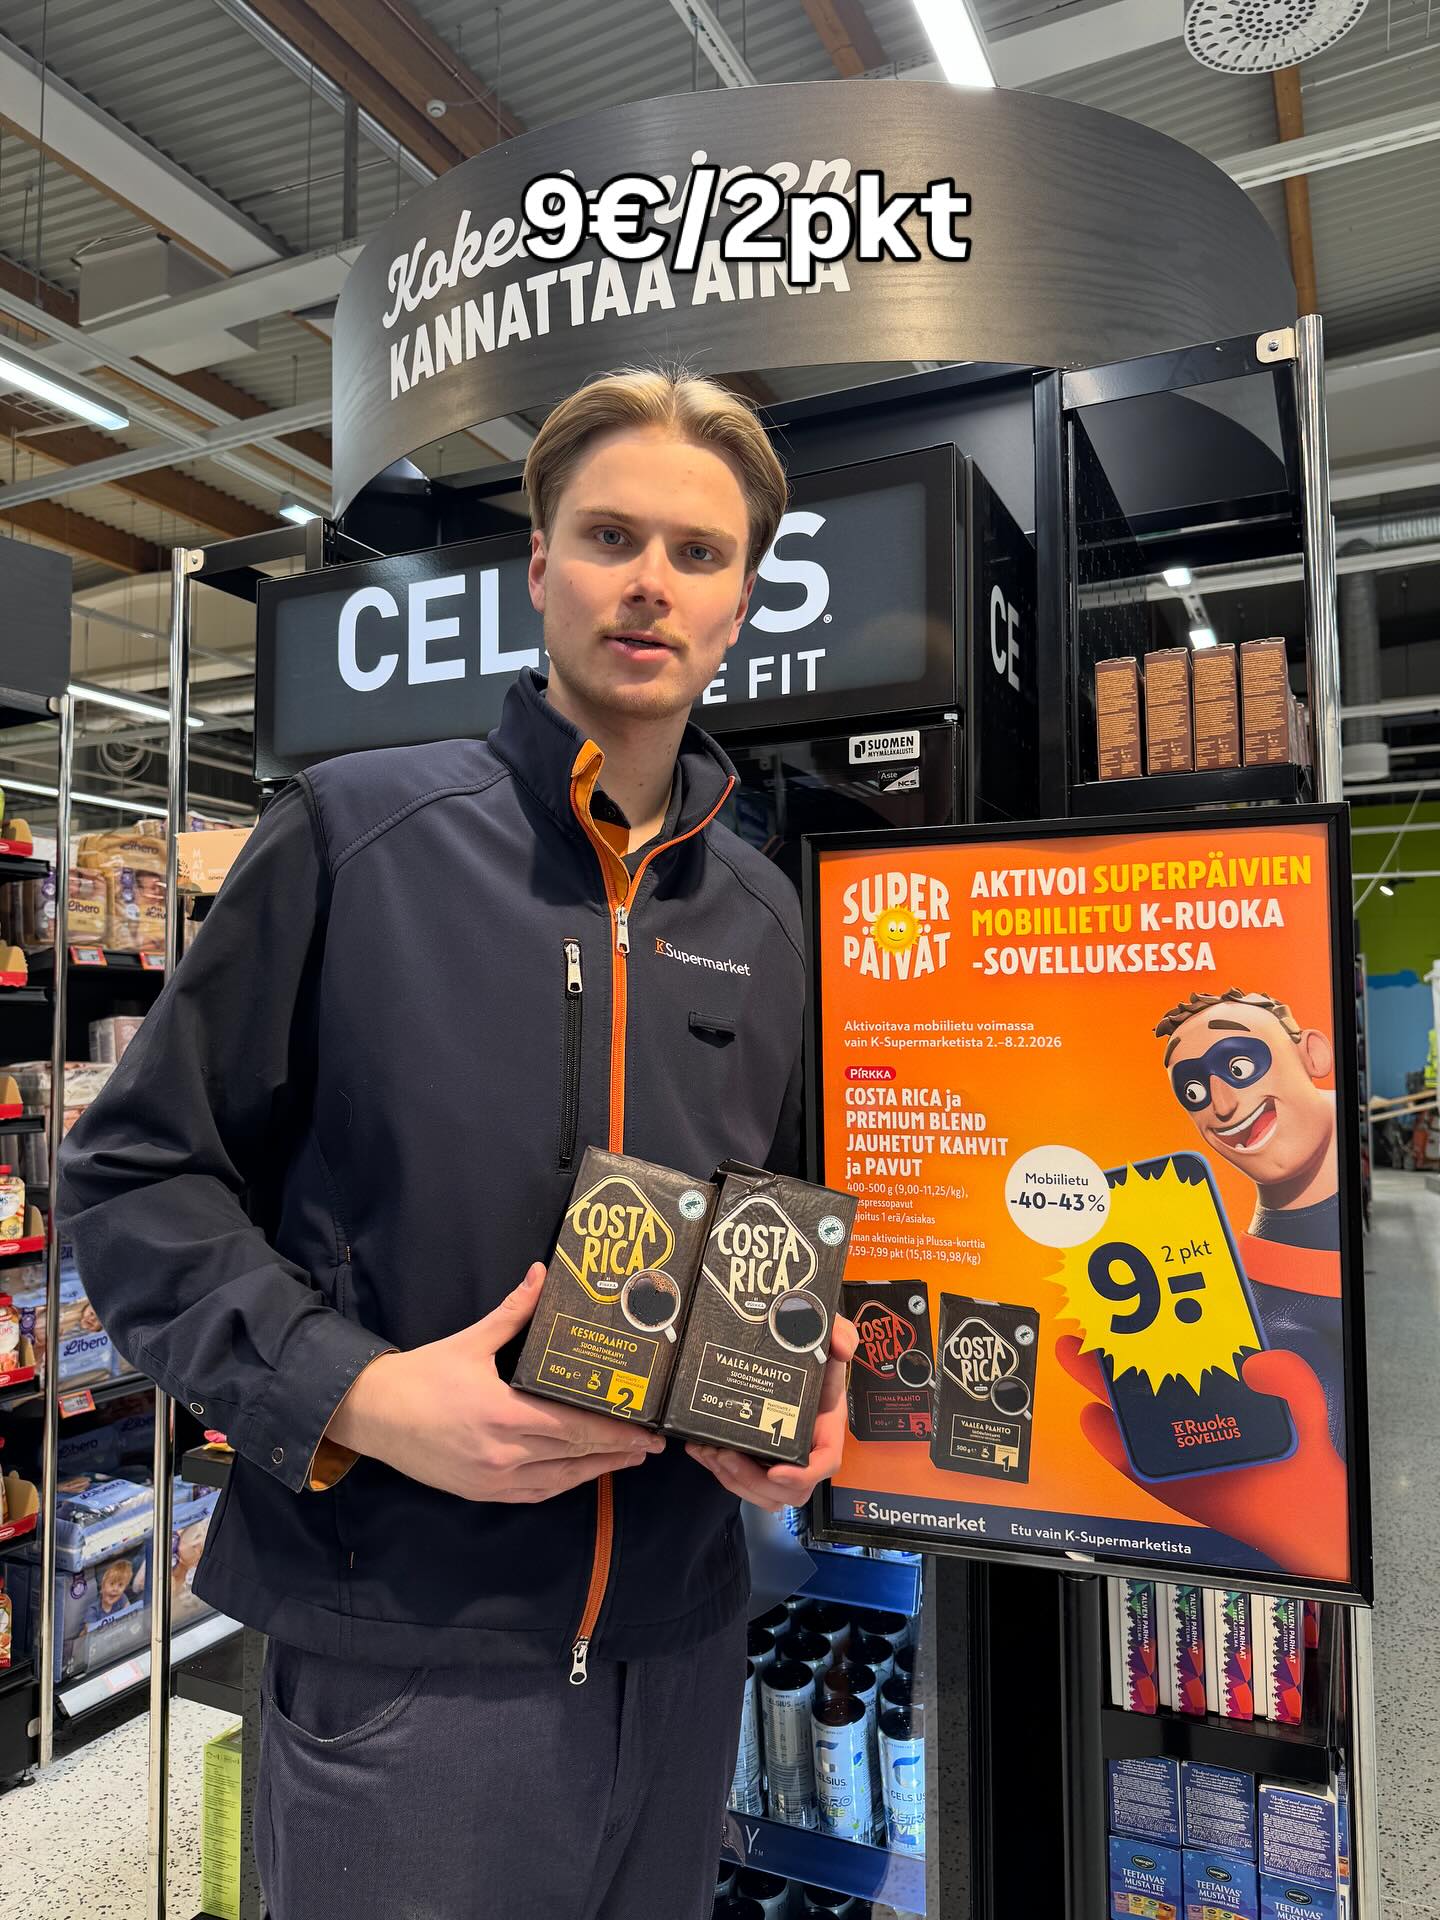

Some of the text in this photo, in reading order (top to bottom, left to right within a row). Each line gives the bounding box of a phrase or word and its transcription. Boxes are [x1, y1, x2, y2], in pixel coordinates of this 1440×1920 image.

[390, 254, 676, 400] KANNATTAA
[748, 648, 826, 700] FIT
[867, 735, 915, 751] SUOMEN
[880, 771, 899, 780] Aste
[897, 779, 918, 787] NCS
[970, 850, 1313, 898] AKTIVOI SUPERPÄIVIEN
[842, 871, 950, 925] SUPER
[971, 898, 1285, 937] MOBIILIETU K-RUOKA
[843, 924, 951, 981] PÄIVÄT
[972, 941, 1217, 976] -SOVELLUKSESSA
[844, 1020, 1034, 1032] Aktivoitava mobiilietu voimassa
[844, 1037, 868, 1048] vain
[870, 1036, 984, 1050] K-Supermarketista
[845, 1087, 961, 1113] COSTA RICA ja
[846, 1110, 987, 1132] PREMIUM BLEND
[846, 1133, 1009, 1157] JAUHETUT KAHVIT
[845, 1157, 923, 1180] ja PAVUT
[1025, 1172, 1089, 1187] Mobiilietu
[847, 1182, 886, 1193] 400-500
[887, 1184, 893, 1196] g
[572, 1201, 657, 1244] COSTA
[881, 1212, 886, 1222] 1
[887, 1213, 936, 1225] erä/asiakas
[717, 1220, 800, 1263] COSTA
[871, 1233, 915, 1245] aktivointia
[916, 1235, 925, 1246] ja
[926, 1235, 986, 1249] Plussa-korttia
[1161, 1239, 1213, 1265] 2 pkt
[580, 1236, 645, 1279] RICA
[890, 1249, 904, 1260] pkt
[728, 1256, 791, 1299] RICA
[64, 1335, 109, 1357] Libero
[570, 1325, 638, 1353] KESKIPAAHTO
[950, 1335, 1006, 1361] COSTA
[865, 1338, 905, 1366] RICA
[549, 1364, 566, 1376] 450
[565, 1371, 572, 1379] g
[716, 1352, 792, 1383] VAALEA PAAHTO
[960, 1358, 1002, 1385] RICA
[611, 1387, 635, 1419] 2
[701, 1393, 718, 1405] 500
[718, 1401, 724, 1409] g
[770, 1417, 784, 1447] 1
[915, 1421, 927, 1439] 3
[960, 1419, 1011, 1435] VAALEA PAAHTO
[1176, 1427, 1241, 1448] SOVELLUS
[1001, 1455, 1010, 1473] 1
[1010, 1523, 1192, 1555] Etu vain K-Supermarketista
[1189, 1593, 1198, 1655] TALVEN PARHAAT
[1237, 1598, 1247, 1660] TALVEN PARHAAT
[1289, 1630, 1297, 1664] PARHAAT
[1121, 1867, 1166, 1885] TEETAIVAS
[1124, 1877, 1151, 1890] MUSTA
[1151, 1883, 1164, 1892] TEE
[1196, 1880, 1242, 1898] TEETAIVAS
[1199, 1889, 1227, 1902] MUSTA
[1227, 1894, 1240, 1905] TEE
[1274, 1902, 1323, 1920] TEETAIVAS
